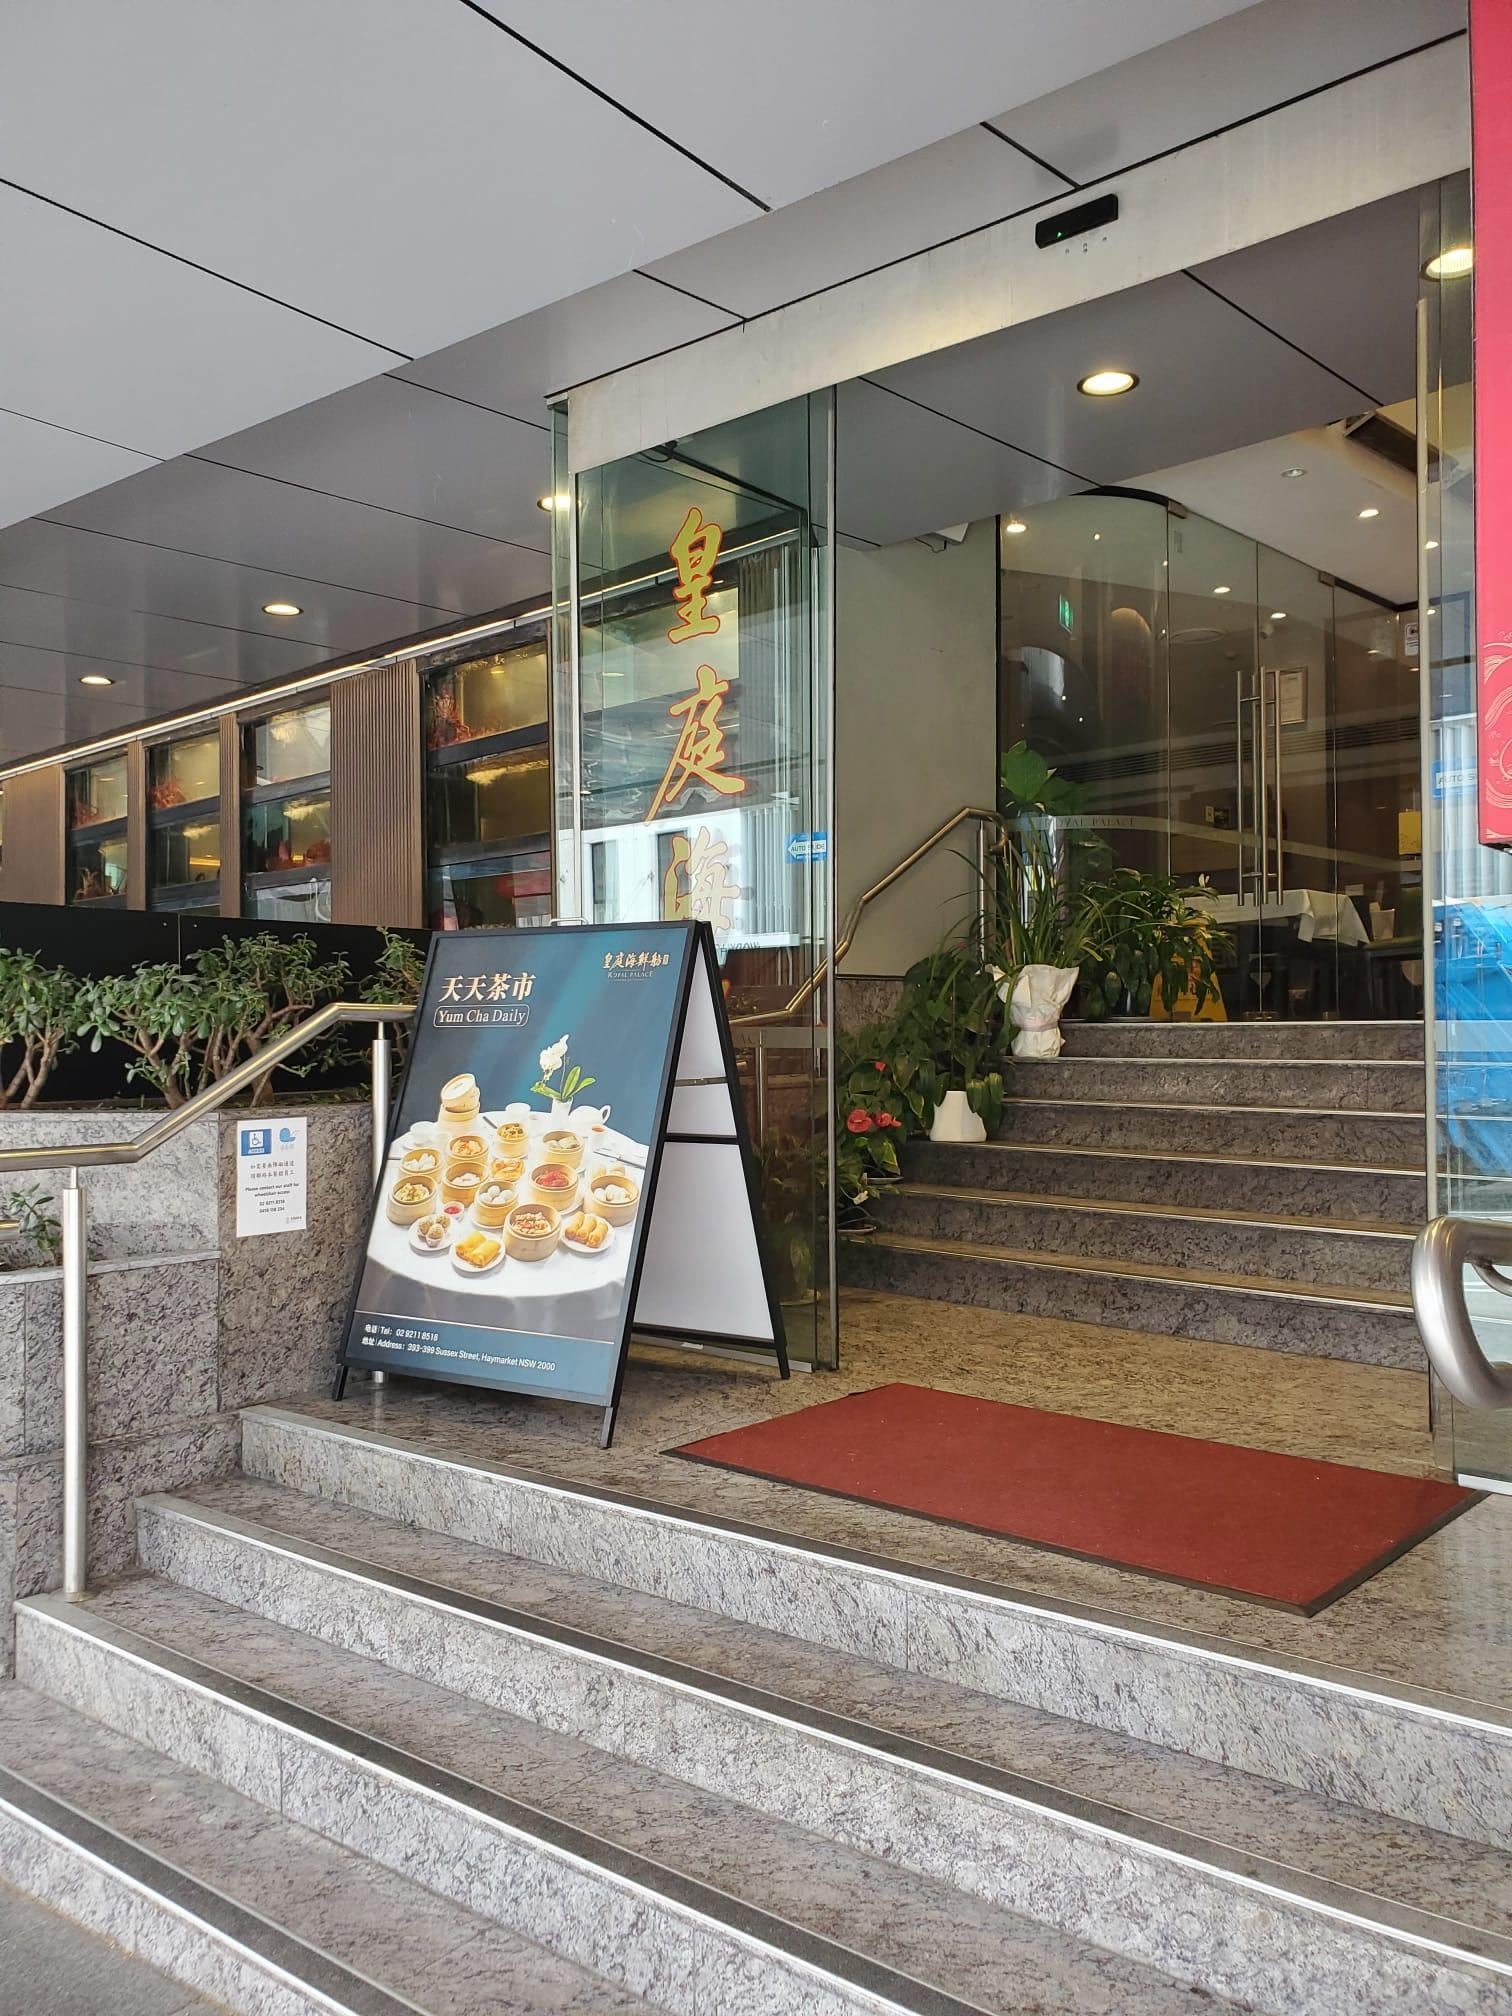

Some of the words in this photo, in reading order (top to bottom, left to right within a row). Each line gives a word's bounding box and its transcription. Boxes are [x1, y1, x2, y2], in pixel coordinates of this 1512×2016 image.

[630, 970, 654, 978] PALACE
[438, 971, 537, 1003] 天天茶市
[438, 1010, 464, 1023] Yum
[466, 1009, 489, 1022] Cha
[492, 1008, 527, 1025] Daily
[396, 1328, 405, 1337] 02
[405, 1329, 421, 1340] 9211
[407, 1343, 435, 1355] 393-399
[435, 1347, 459, 1358] Sussex
[459, 1350, 481, 1362] Street,
[481, 1353, 518, 1366] Haymarket
[518, 1359, 538, 1369] NSW
[537, 1361, 556, 1371] 2000
